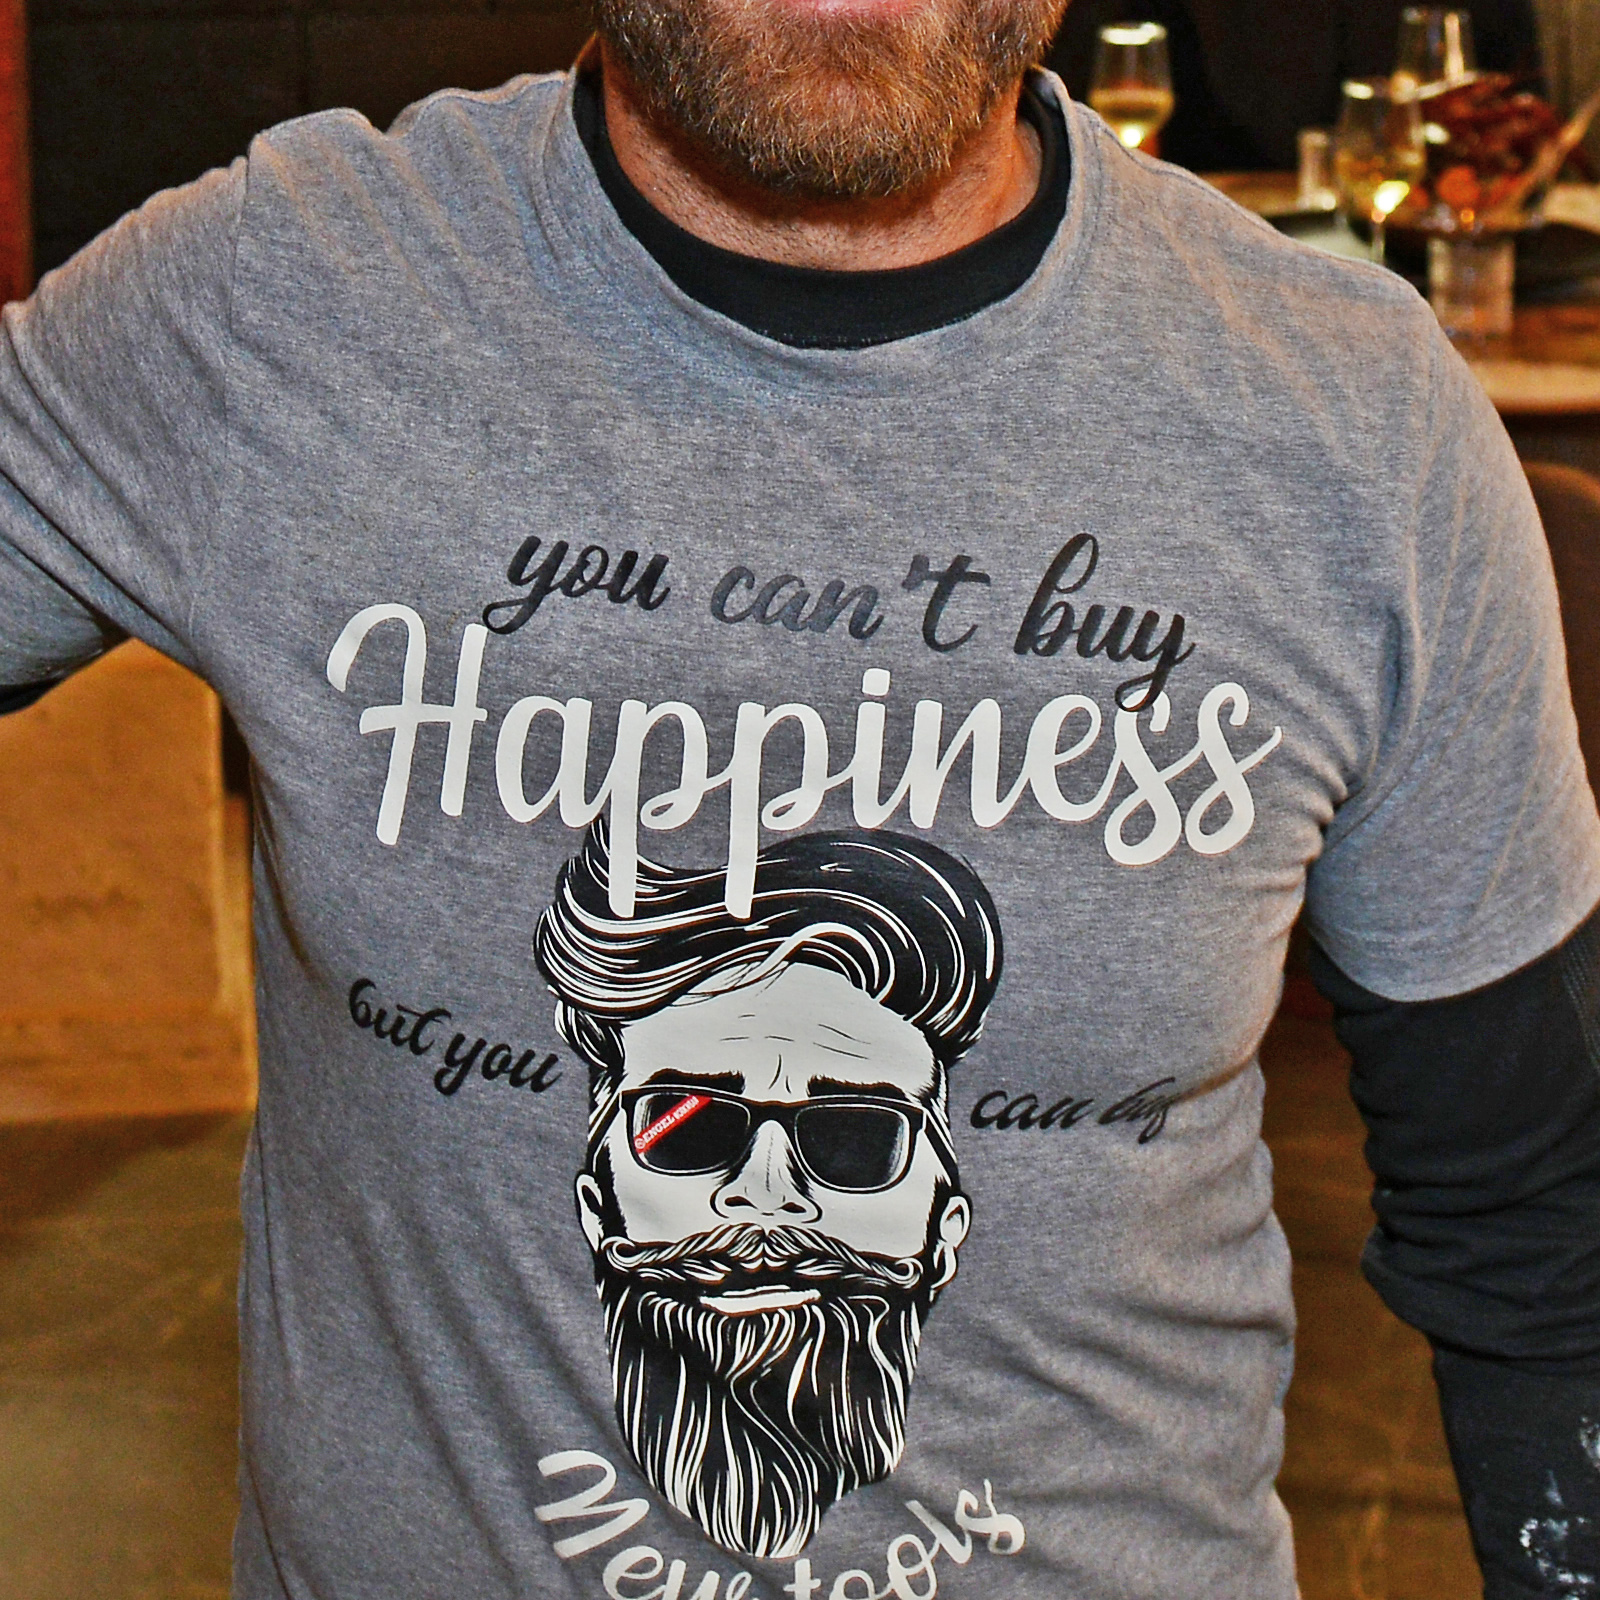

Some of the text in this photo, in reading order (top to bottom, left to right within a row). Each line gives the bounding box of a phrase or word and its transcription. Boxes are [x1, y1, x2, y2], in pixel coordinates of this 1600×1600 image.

[483, 532, 1196, 713] you can't buy
[326, 602, 1282, 918] Happiness
[348, 977, 453, 1056] but
[433, 1032, 563, 1096] you
[969, 1089, 1096, 1131] can
